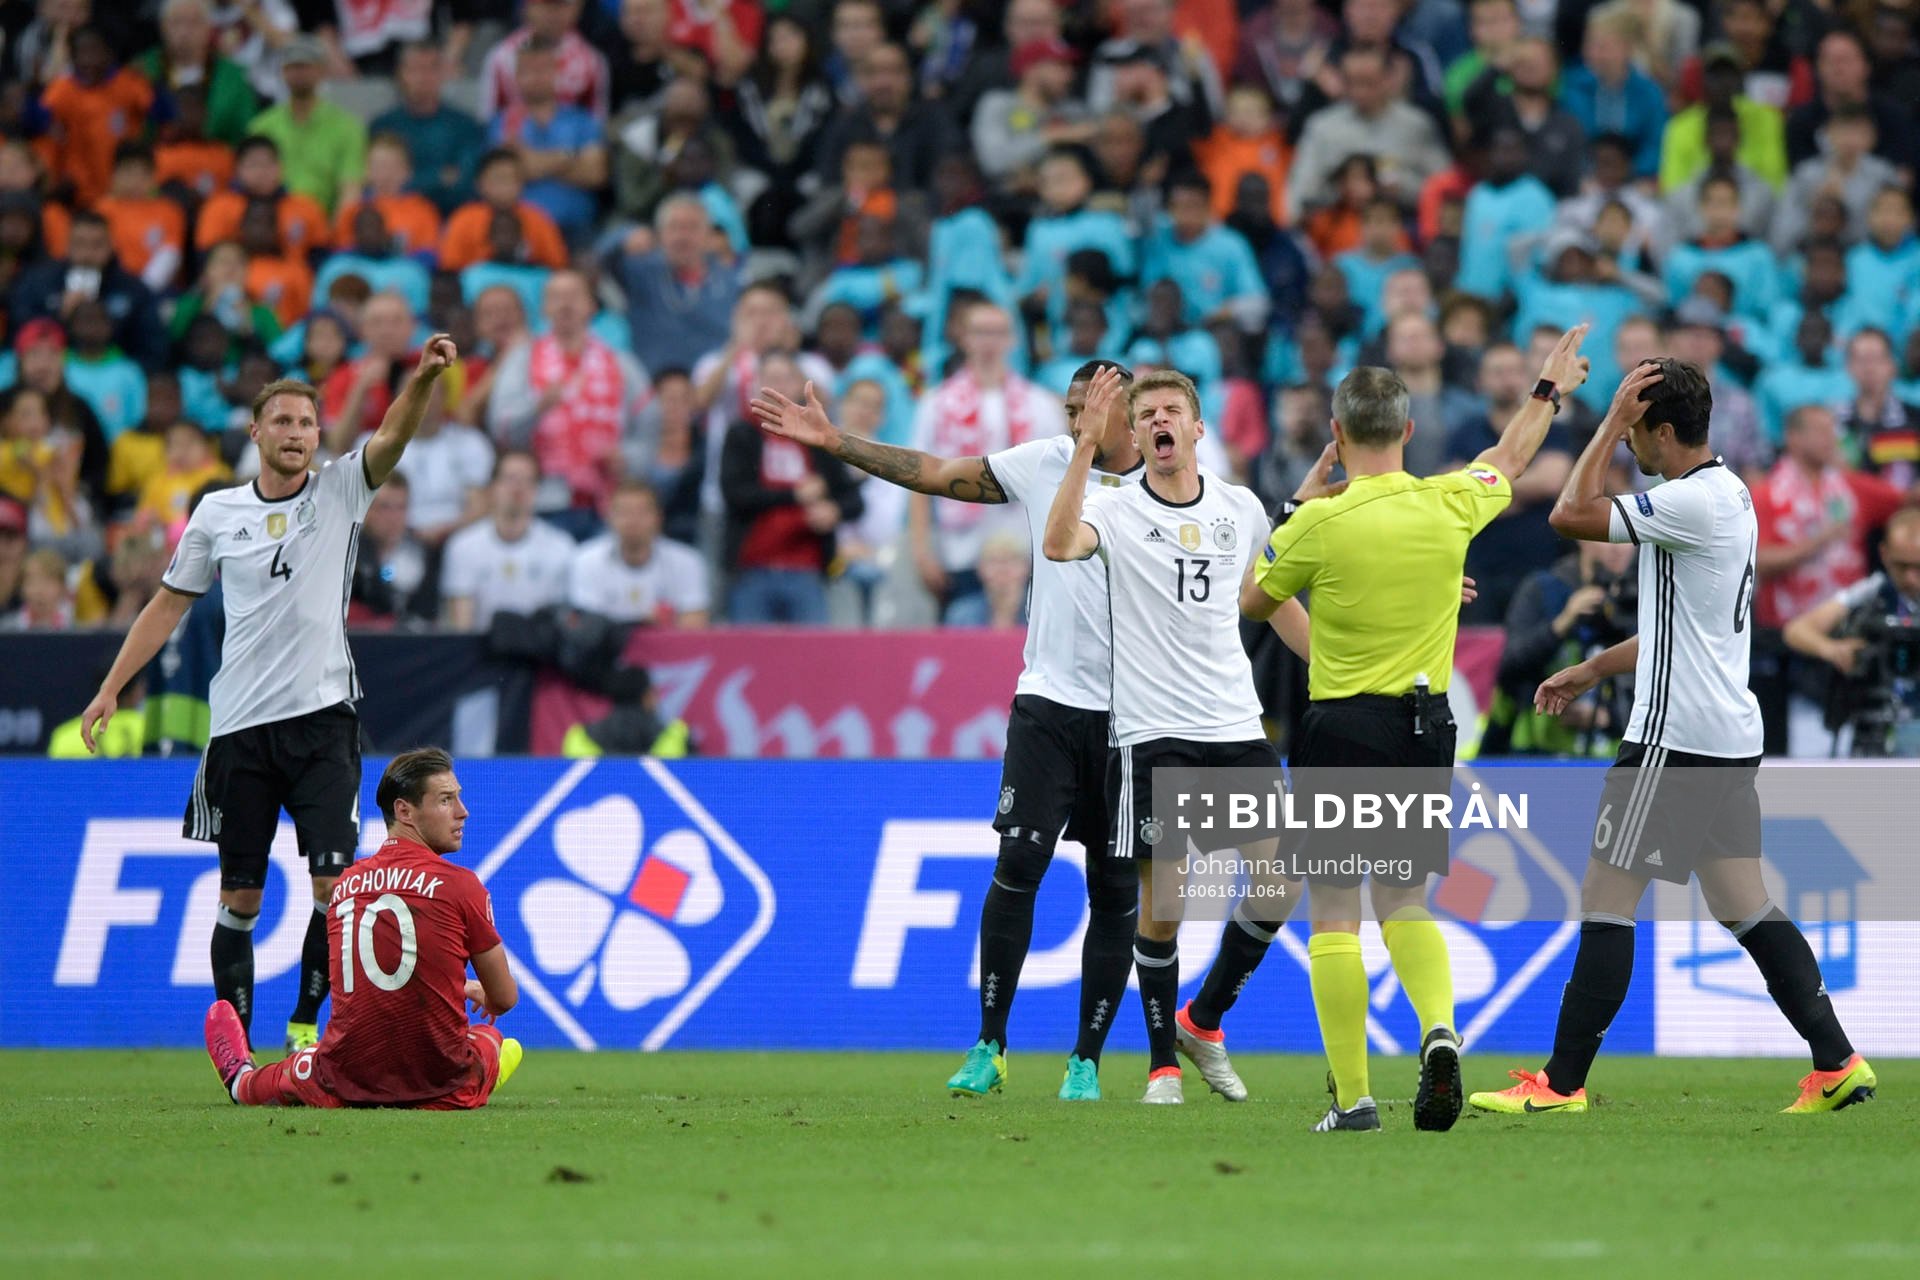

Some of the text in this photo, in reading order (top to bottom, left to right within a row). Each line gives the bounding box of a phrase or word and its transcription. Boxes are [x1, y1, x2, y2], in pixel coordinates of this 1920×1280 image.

[270, 544, 293, 582] 4
[1174, 558, 1210, 603] 13
[1594, 803, 1613, 850] 6
[328, 867, 444, 907] RYCHOWIAK
[336, 893, 418, 993] 10
